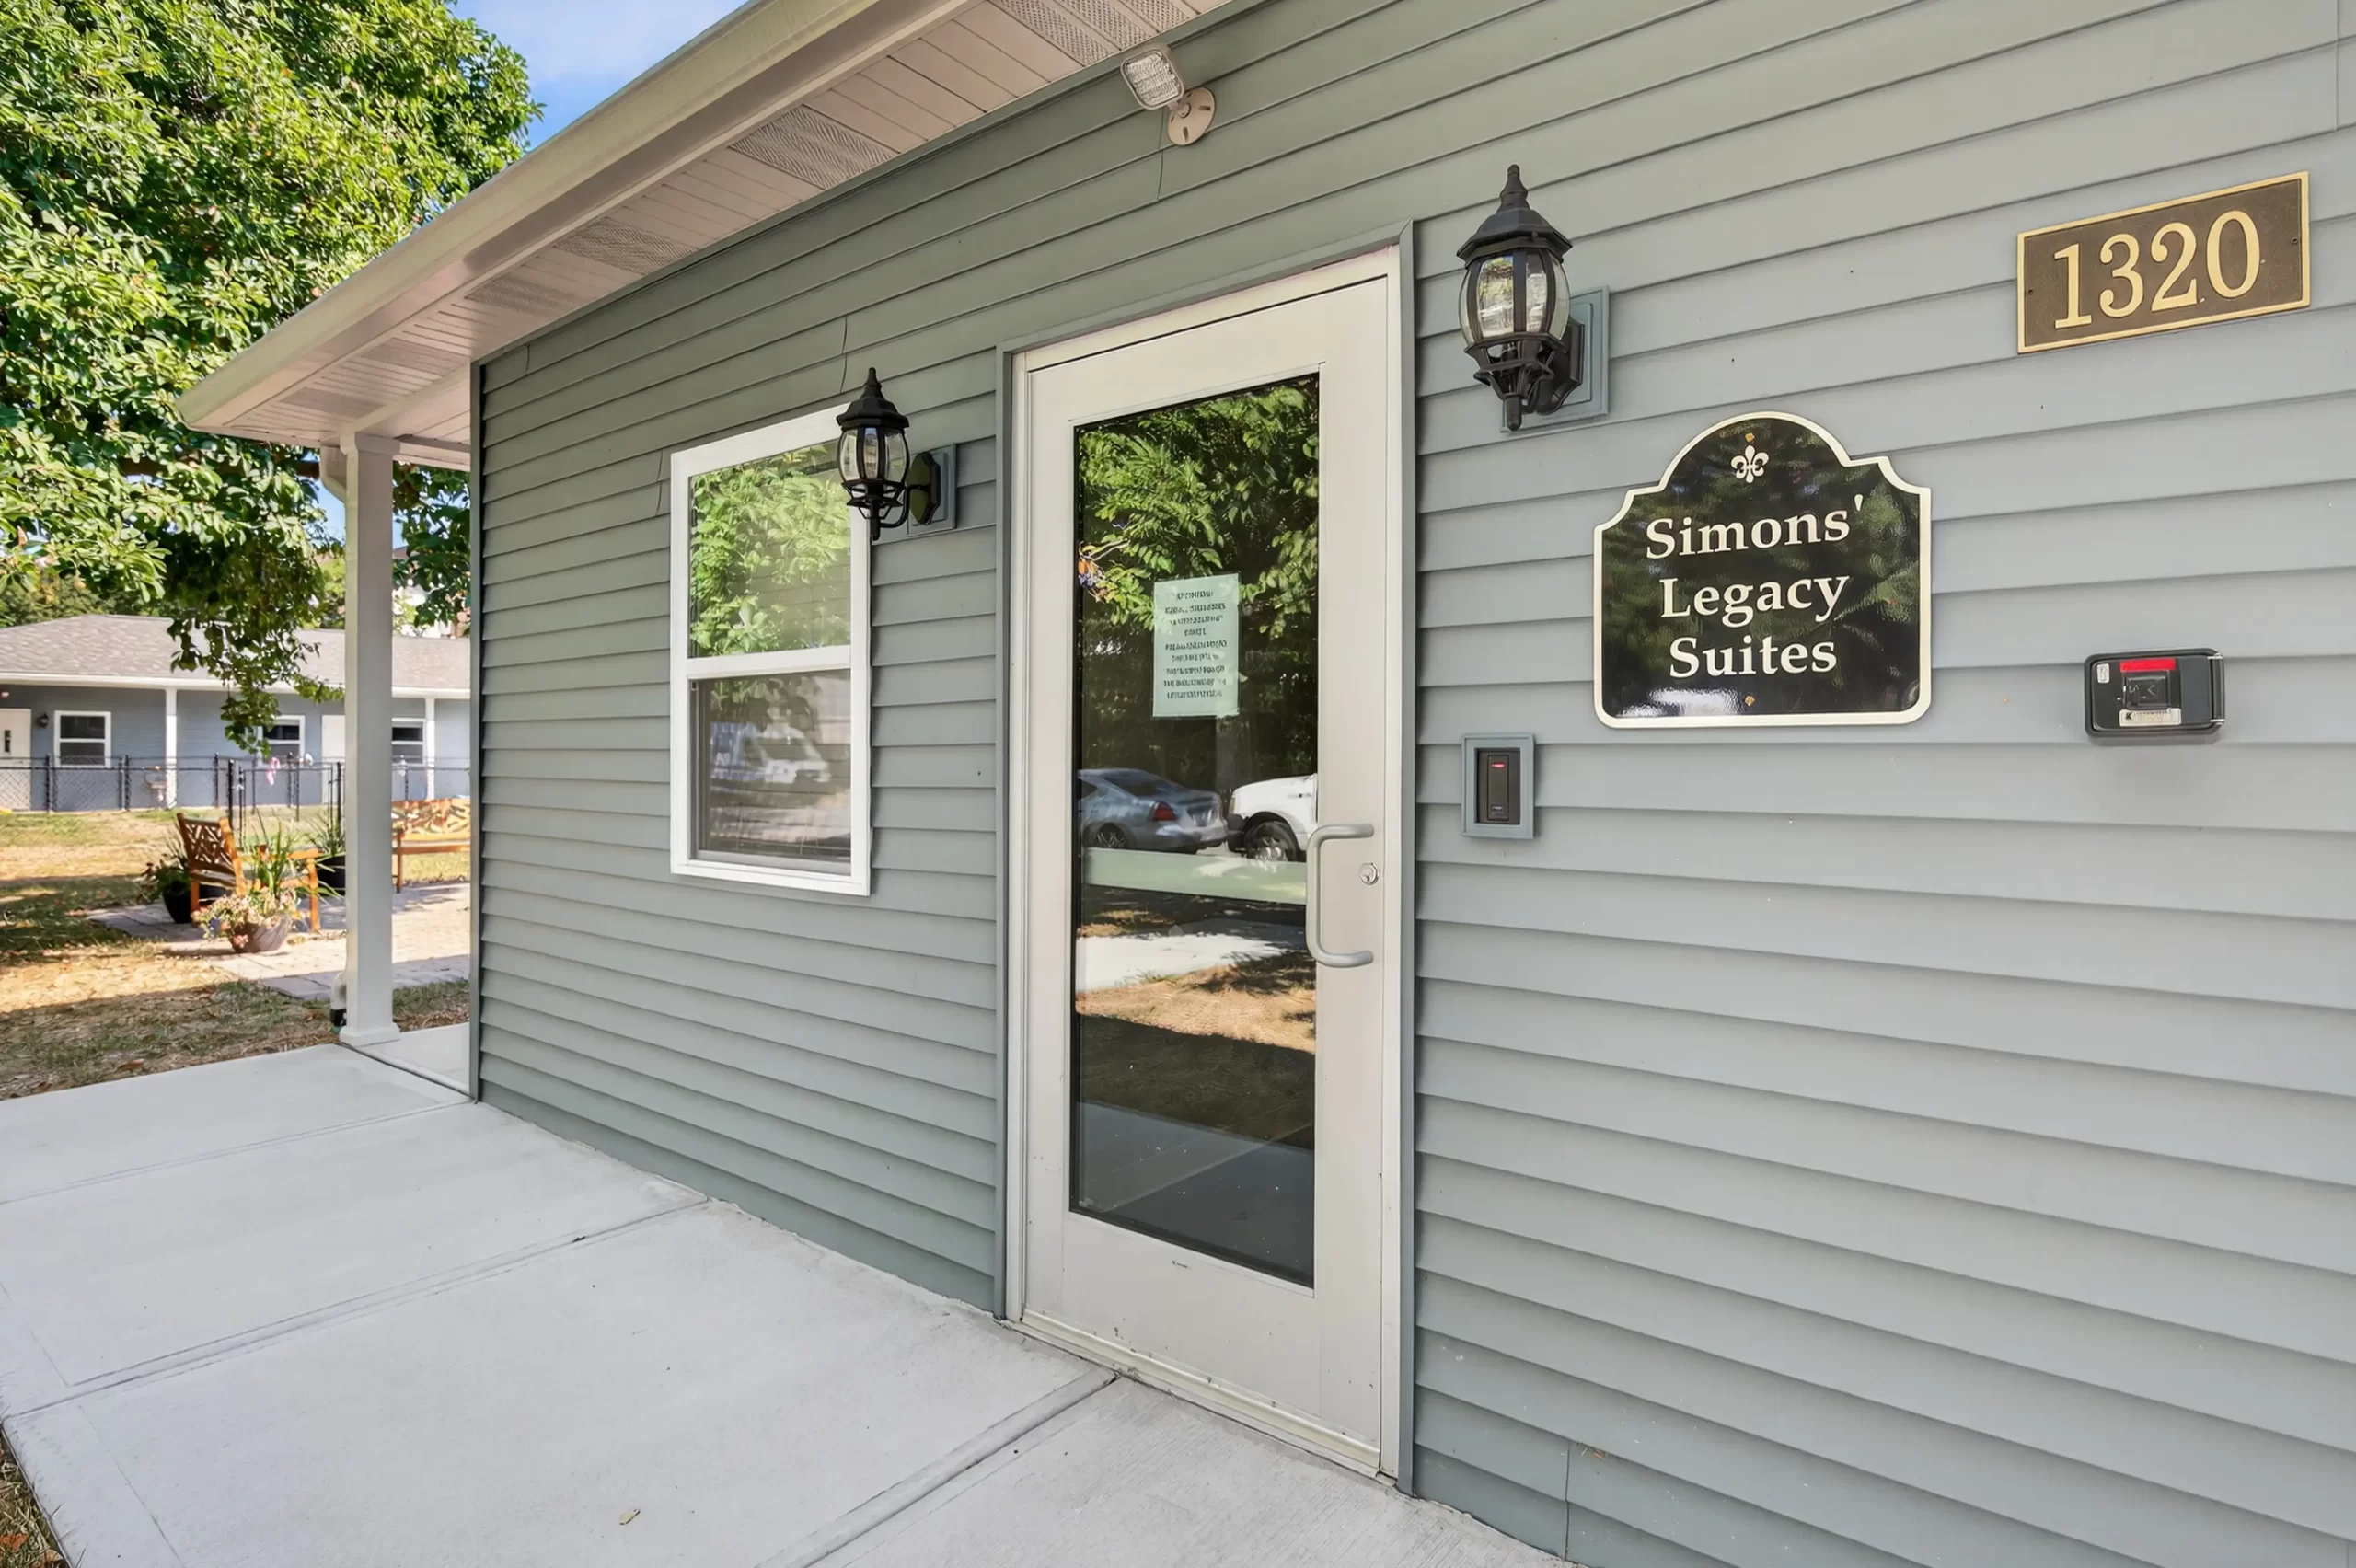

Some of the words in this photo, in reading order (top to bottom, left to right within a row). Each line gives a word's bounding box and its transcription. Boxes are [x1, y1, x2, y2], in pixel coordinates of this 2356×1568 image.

[2053, 210, 2261, 329] 1320
[1646, 493, 1865, 559] Simons'
[1658, 574, 1850, 628] Legacy
[1669, 634, 1838, 679] Suites
